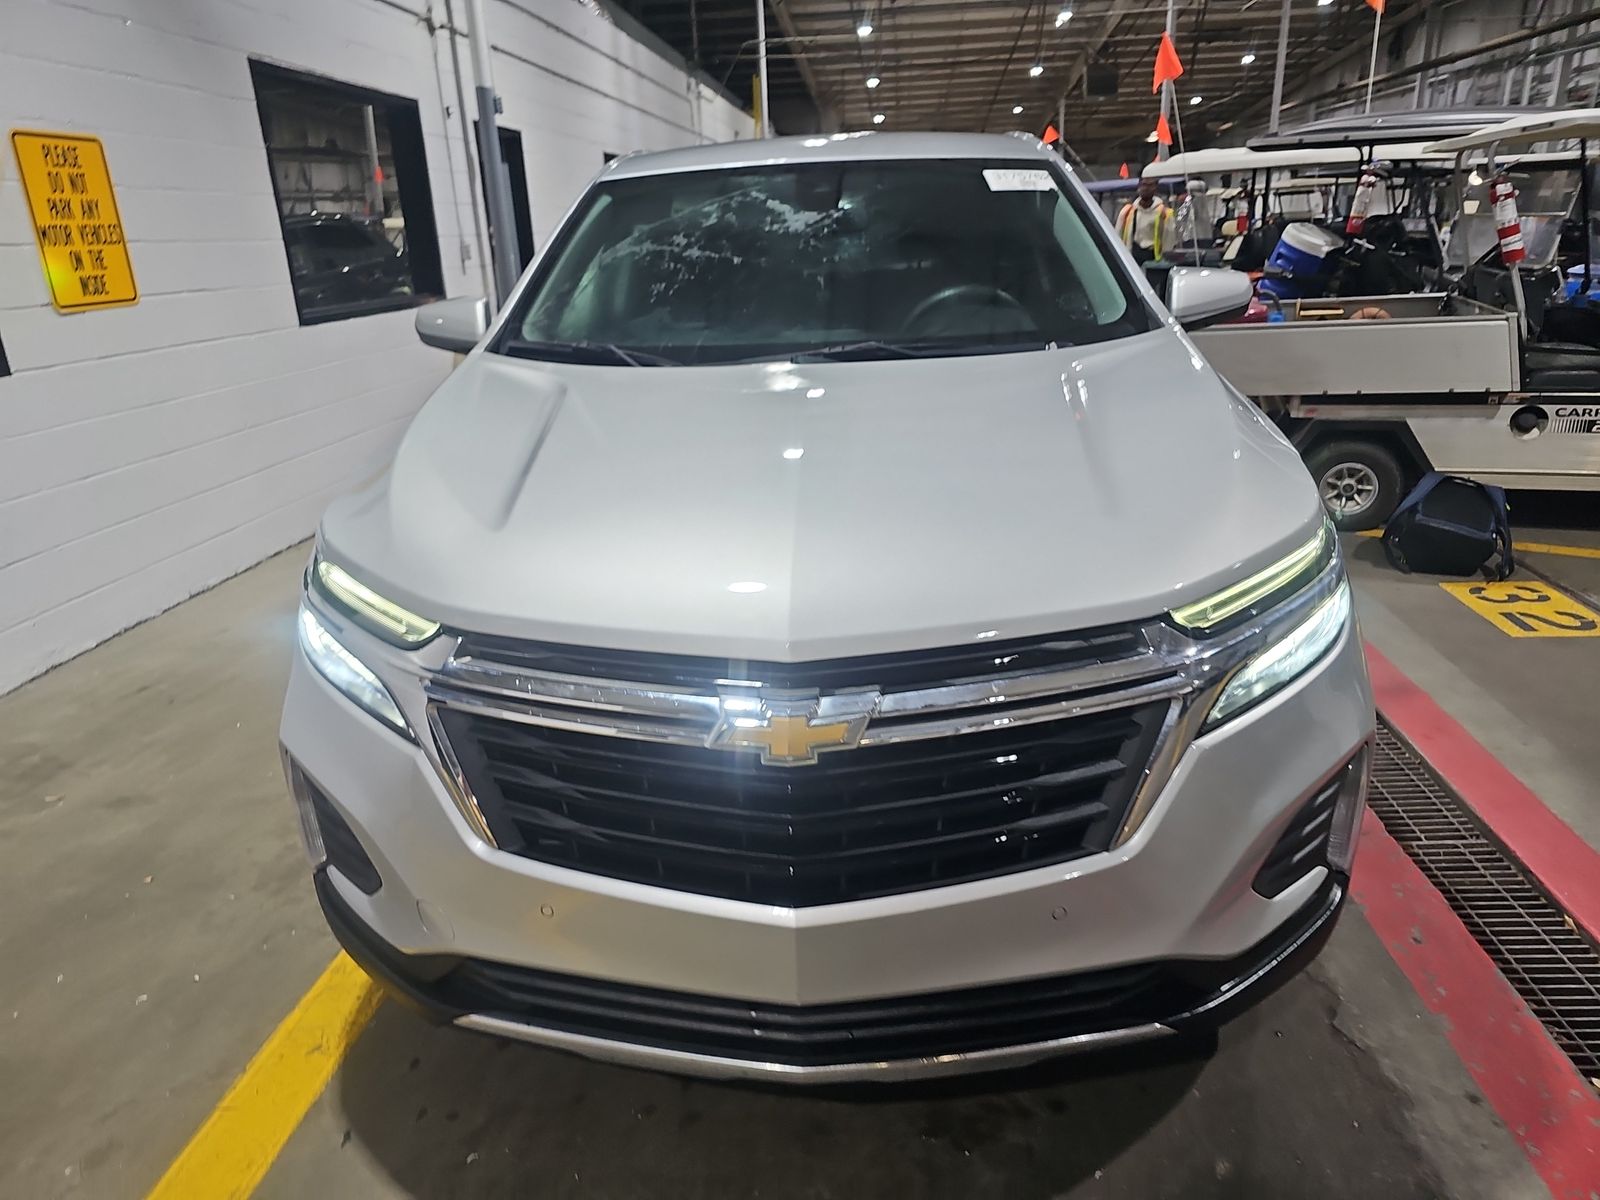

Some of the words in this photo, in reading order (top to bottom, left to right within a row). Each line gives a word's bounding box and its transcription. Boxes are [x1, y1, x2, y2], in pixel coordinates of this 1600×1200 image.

[41, 143, 83, 169] PLEASE
[47, 171, 65, 194] DO
[68, 172, 89, 196] NOT
[47, 198, 76, 221] PARK
[80, 198, 100, 221] ANY
[38, 223, 75, 248] MOTOR
[78, 223, 123, 246] VEHICLES
[69, 250, 85, 273] ON
[87, 249, 108, 272] THE
[1468, 586, 1598, 632] 32
